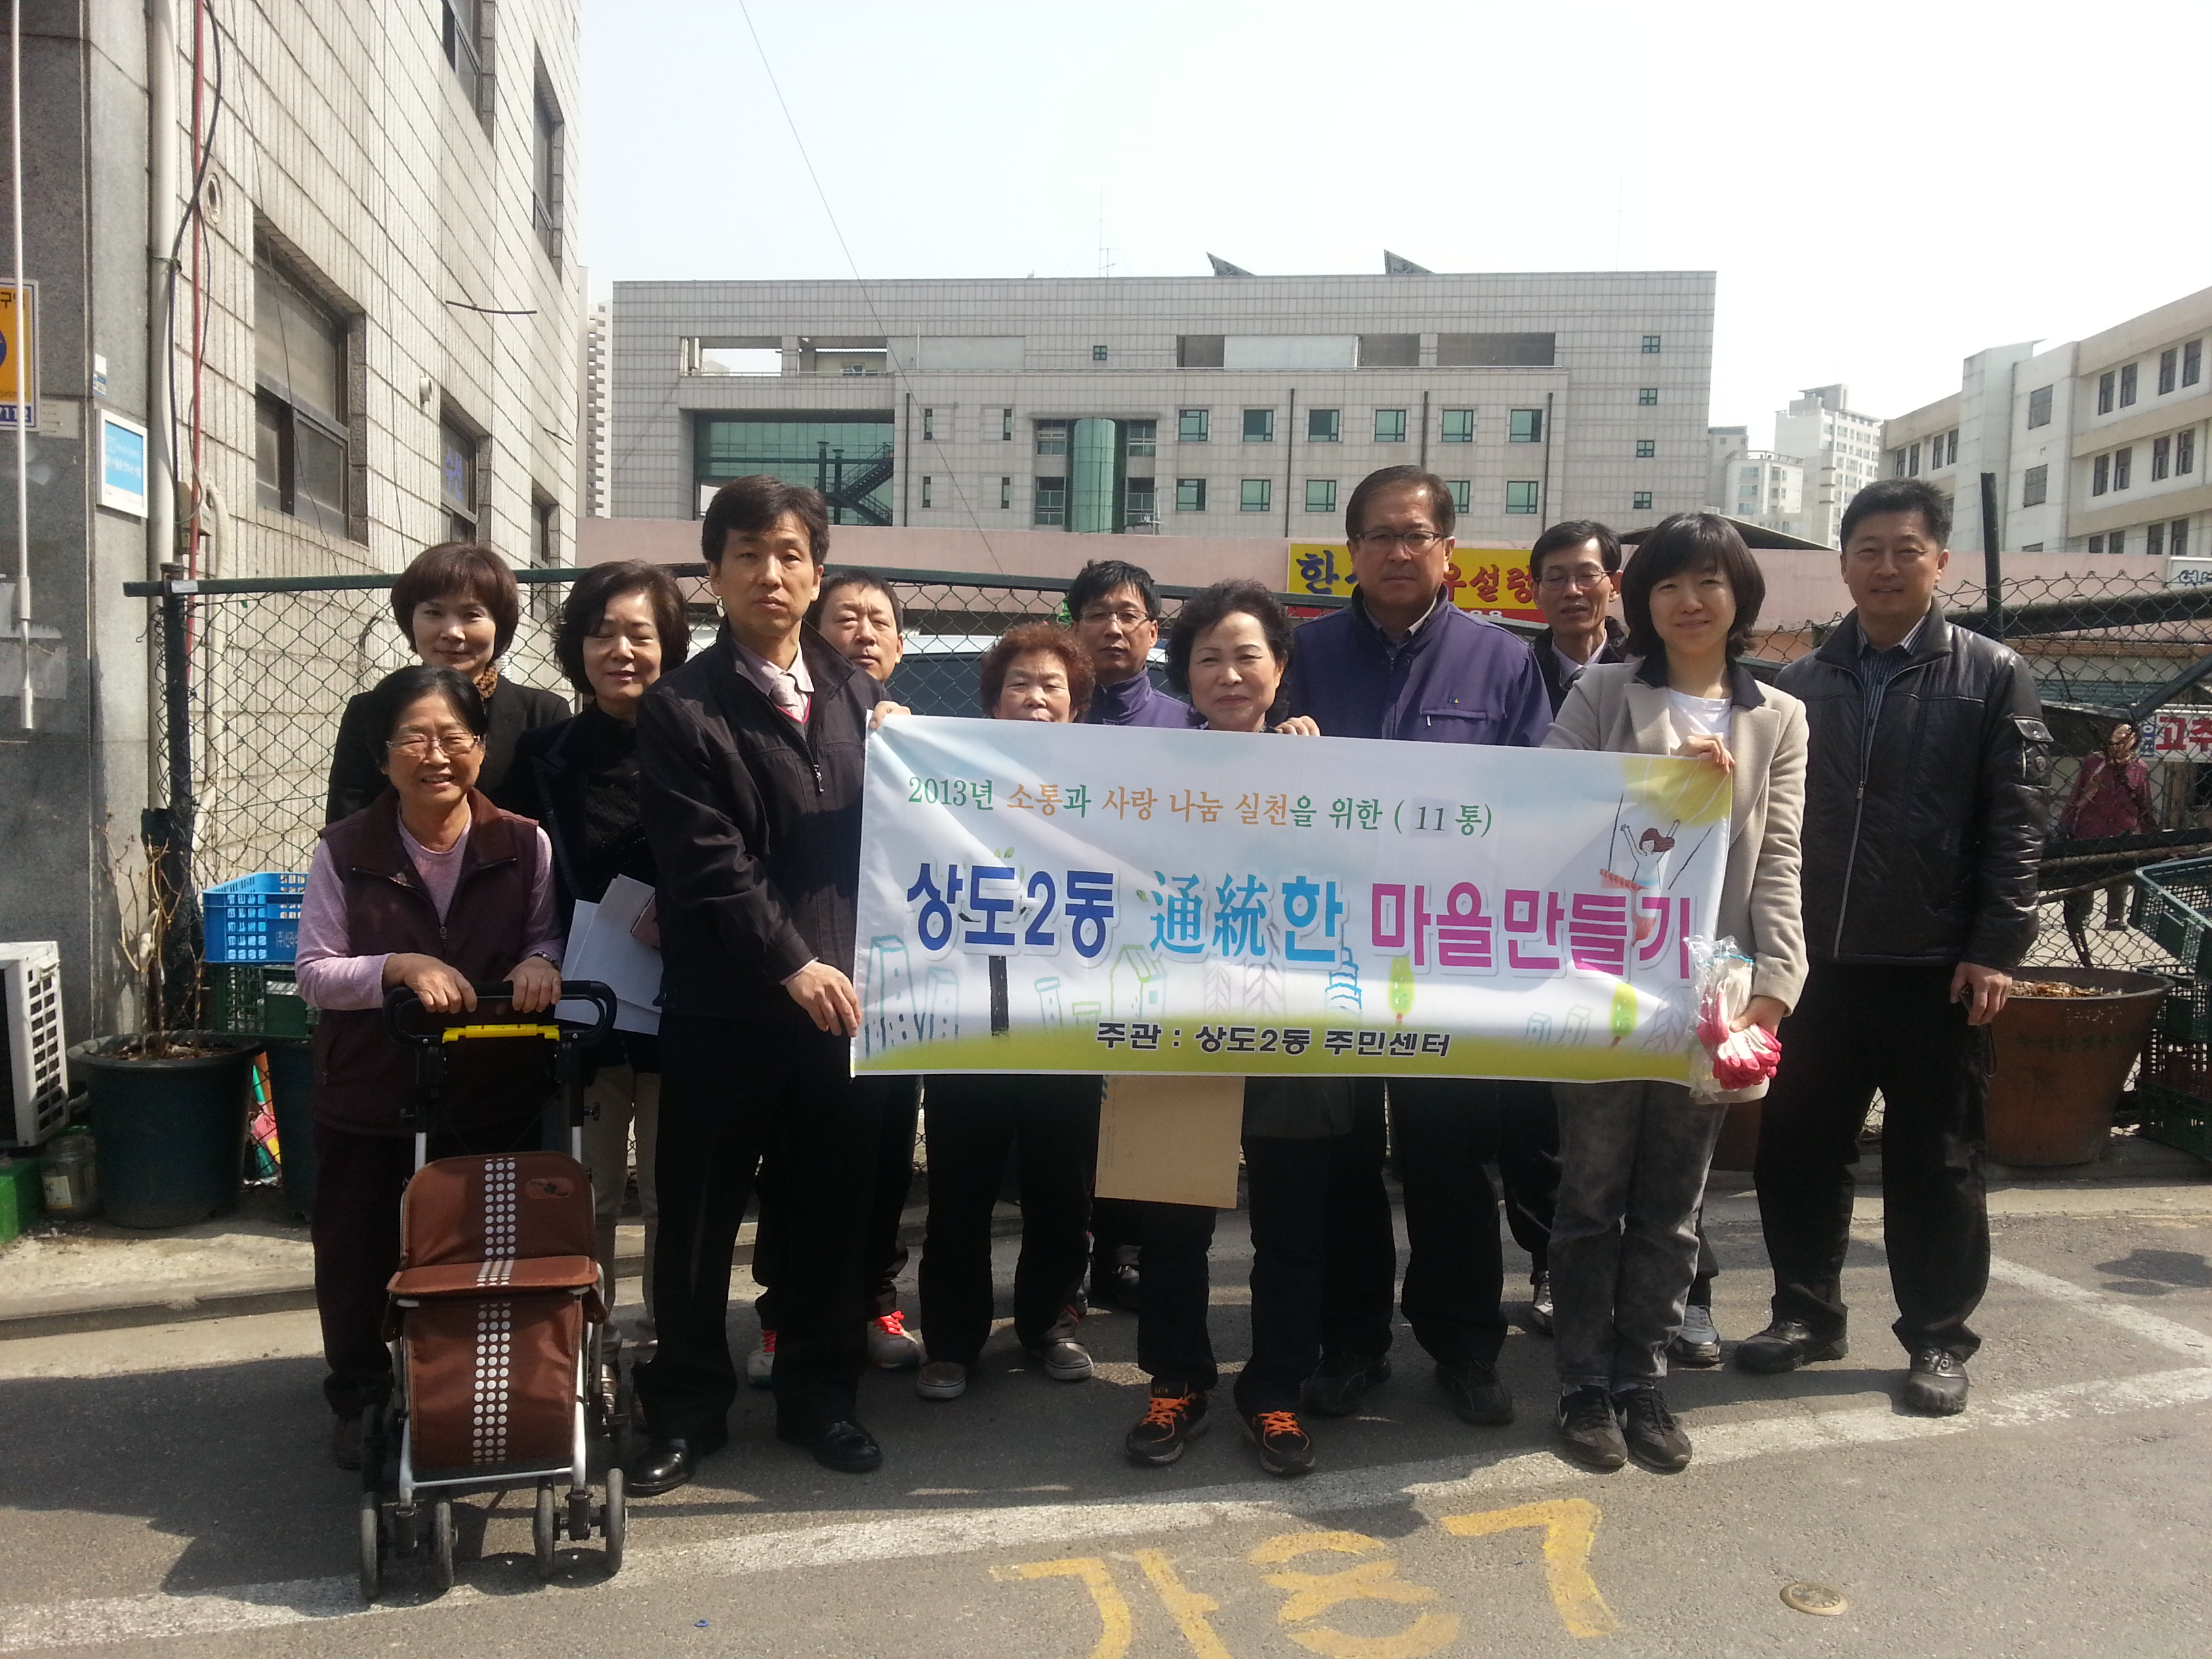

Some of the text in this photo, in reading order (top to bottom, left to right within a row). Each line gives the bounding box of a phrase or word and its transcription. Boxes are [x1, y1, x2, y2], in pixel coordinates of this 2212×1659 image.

[908, 777, 994, 811] 2013년
[1006, 783, 1092, 818] 소통과
[1101, 786, 1158, 821] 사랑
[1169, 789, 1224, 823] 나눔
[1234, 792, 1317, 828] 실천을
[1328, 796, 1383, 831] 위한
[907, 863, 1115, 958] 상도2동
[1372, 882, 1691, 980] 마을만들기
[1095, 1021, 1162, 1050] 주관
[1195, 1025, 1312, 1054] 상도2동
[1324, 1029, 1451, 1057] 주민센터
